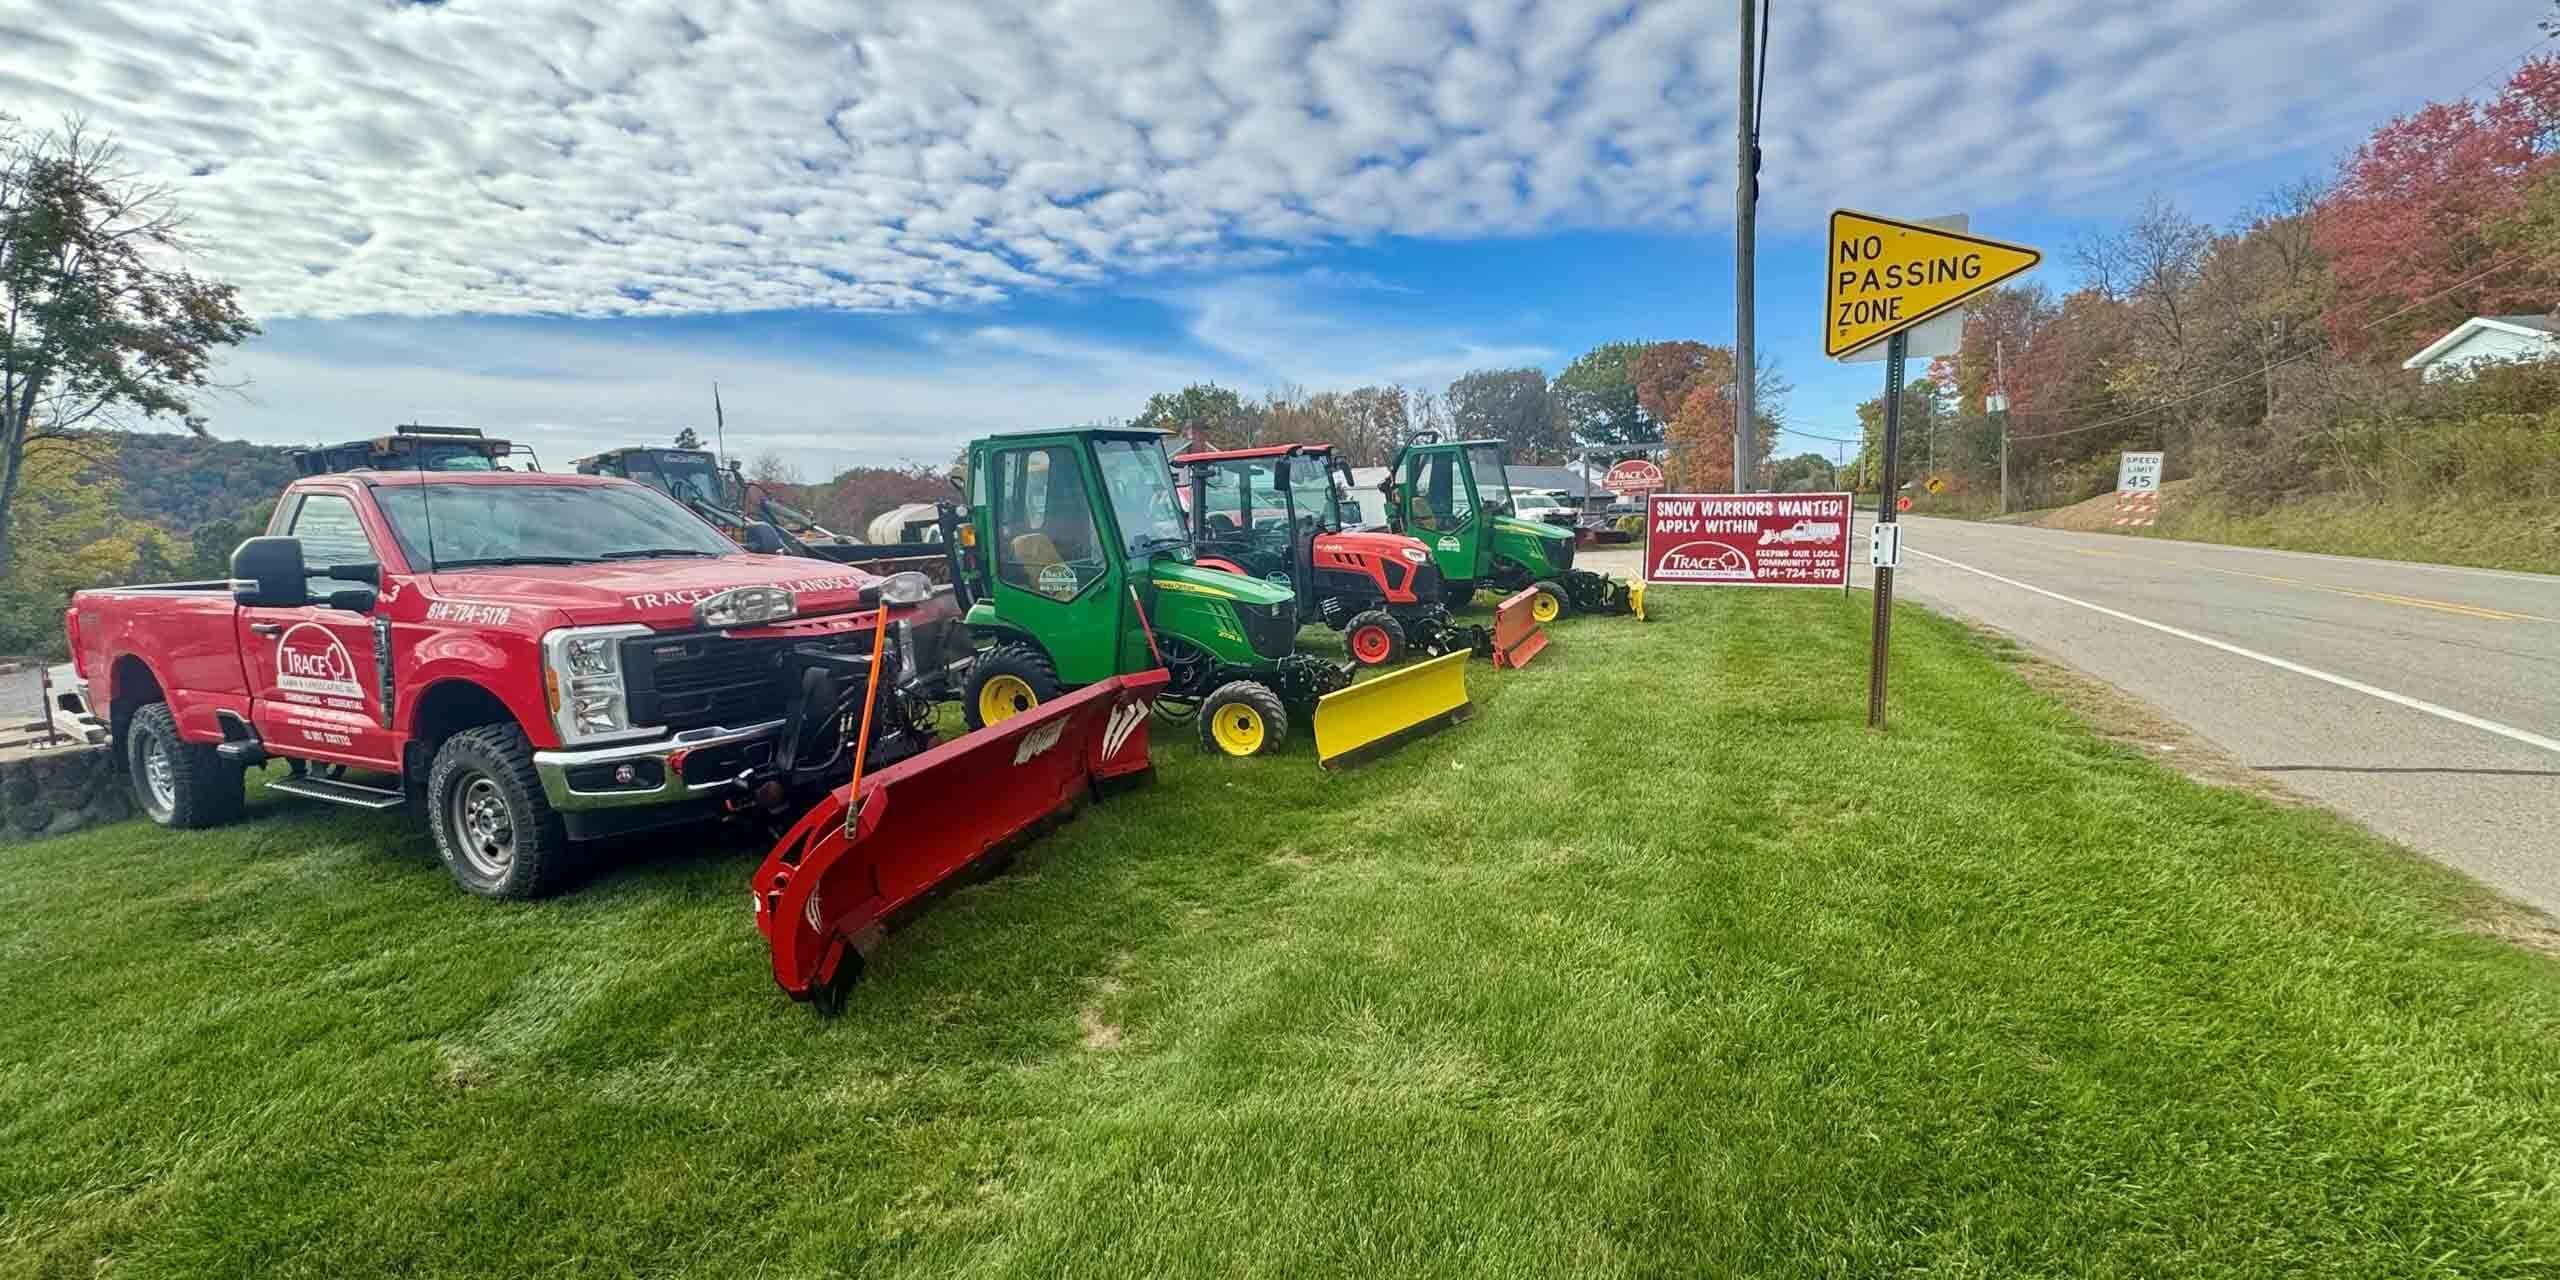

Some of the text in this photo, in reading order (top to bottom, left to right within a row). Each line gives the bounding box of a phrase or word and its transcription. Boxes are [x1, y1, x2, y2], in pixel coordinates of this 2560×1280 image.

[1840, 235, 1882, 265] NO
[1839, 254, 1981, 295] PASSING
[1838, 296, 1903, 326] ZONE
[2127, 456, 2159, 464] SPEED
[1613, 470, 1641, 480] TRACE
[2127, 465, 2154, 473] LIMIT
[2127, 475, 2152, 488] 45
[1656, 500, 1843, 517] SNOW WARRIORS WANTED!
[1656, 520, 1759, 534] APPLY WITHIN
[1755, 549, 1841, 558] KEEPING OUR LOCAL
[1671, 554, 1719, 570] TRACE
[1757, 559, 1837, 567] COMMUNITY SAFE
[1756, 568, 1842, 579] 814-724-5178
[625, 588, 704, 611] TRACE
[426, 601, 511, 625] 814-724-5178
[283, 646, 327, 676] TRACE
